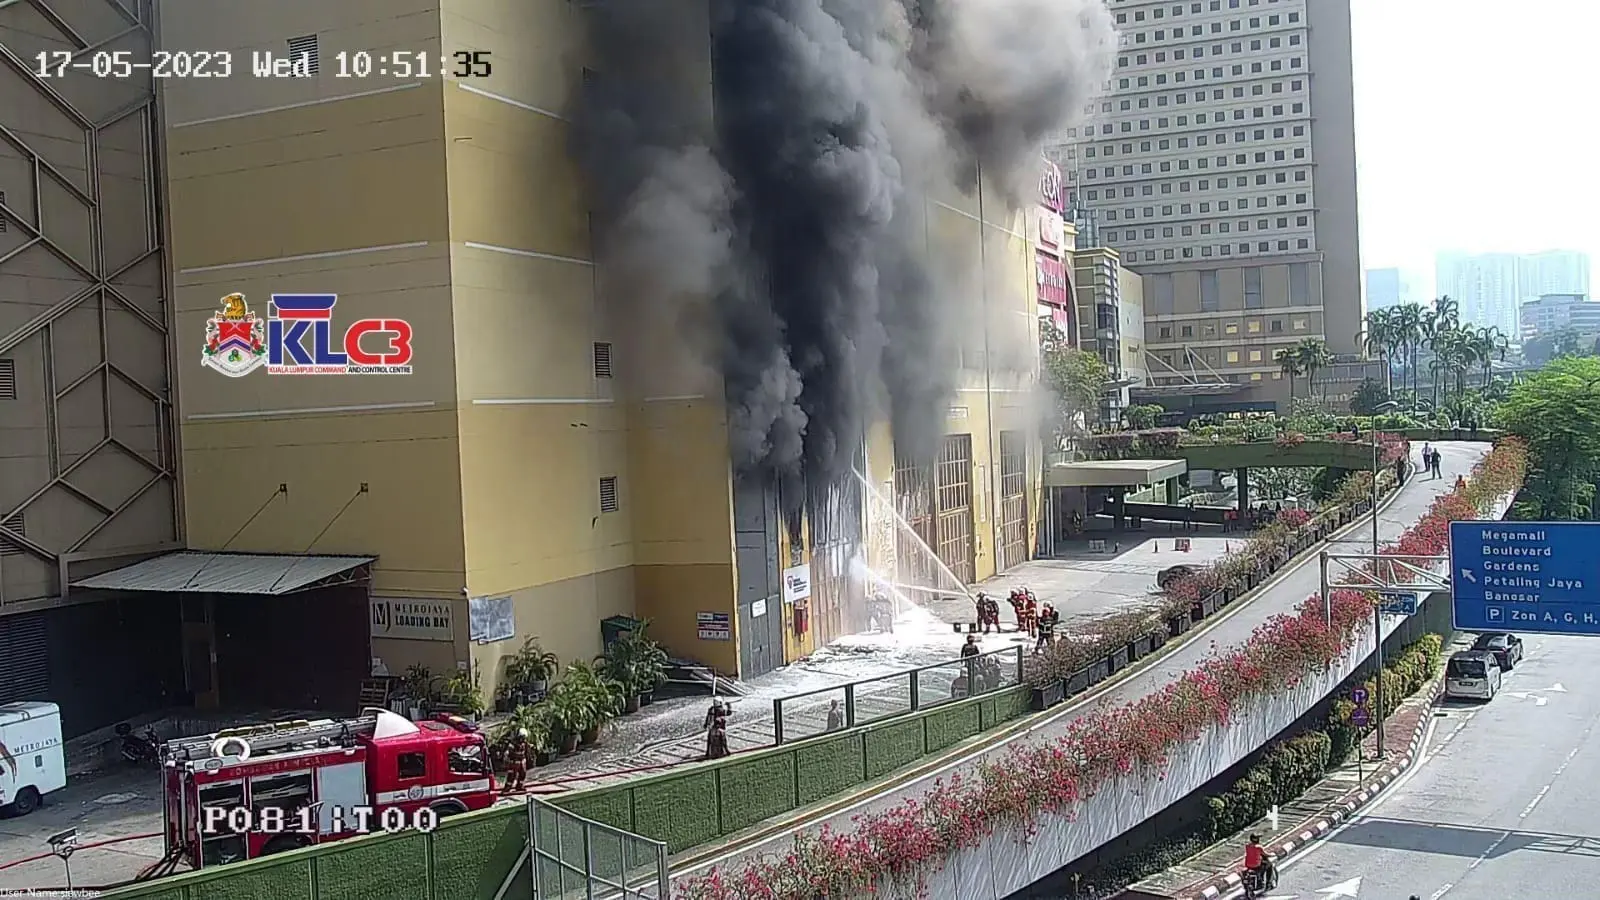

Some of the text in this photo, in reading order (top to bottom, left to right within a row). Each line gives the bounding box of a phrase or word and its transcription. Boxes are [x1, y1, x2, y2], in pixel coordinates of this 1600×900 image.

[1482, 530, 1545, 542] Megamall
[1482, 545, 1551, 556] Boulevard
[1483, 561, 1540, 571] Gardens
[1484, 576, 1582, 590] Petaling Jaya
[394, 603, 450, 614] METROJAYA
[395, 615, 450, 628] LOADING BAY
[1511, 610, 1537, 620] Zon
[1543, 612, 1558, 623] A,
[1564, 612, 1577, 624] G,
[14, 737, 58, 753] METROJAYA
